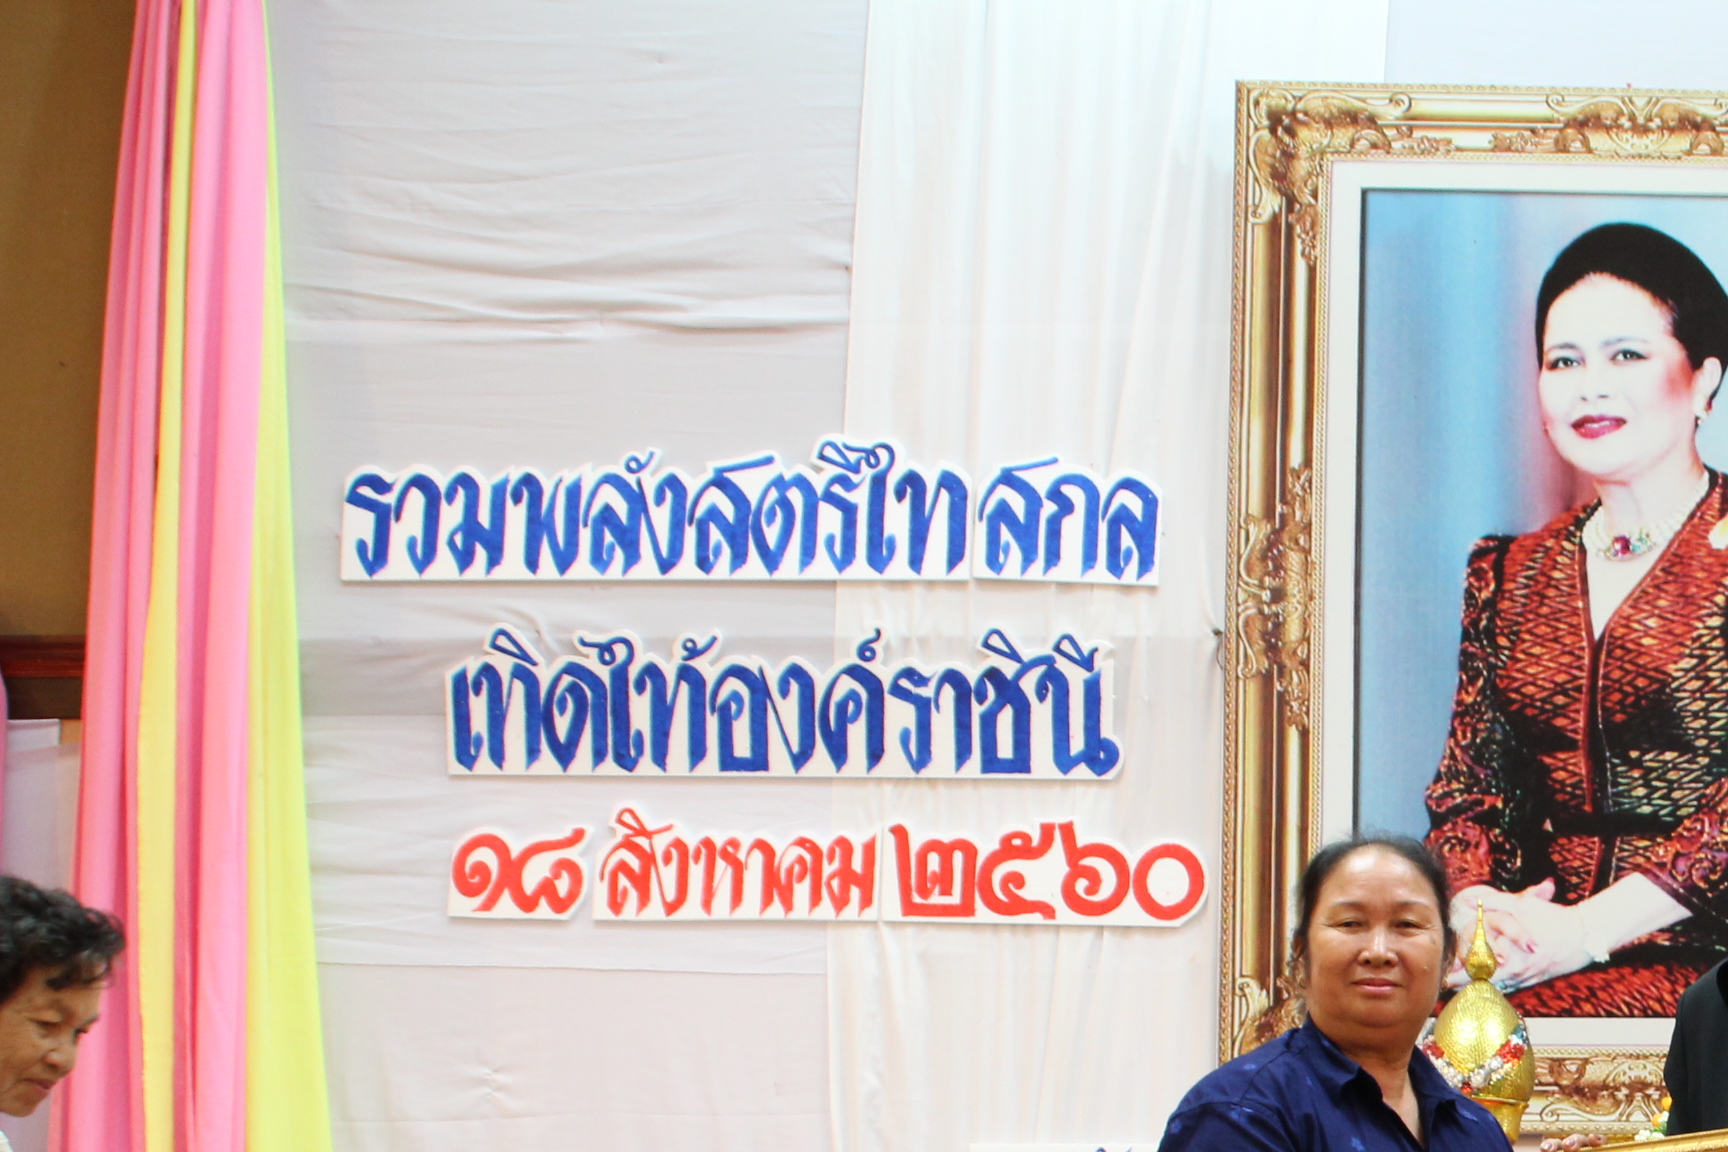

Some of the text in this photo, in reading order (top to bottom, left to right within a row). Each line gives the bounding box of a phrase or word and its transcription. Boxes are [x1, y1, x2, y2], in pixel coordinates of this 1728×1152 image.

[452, 627, 1120, 777] เทิดไท้องค์ราชินี
[452, 808, 1206, 920] ๑๘ สิงหาคม ๒๕๖๐
